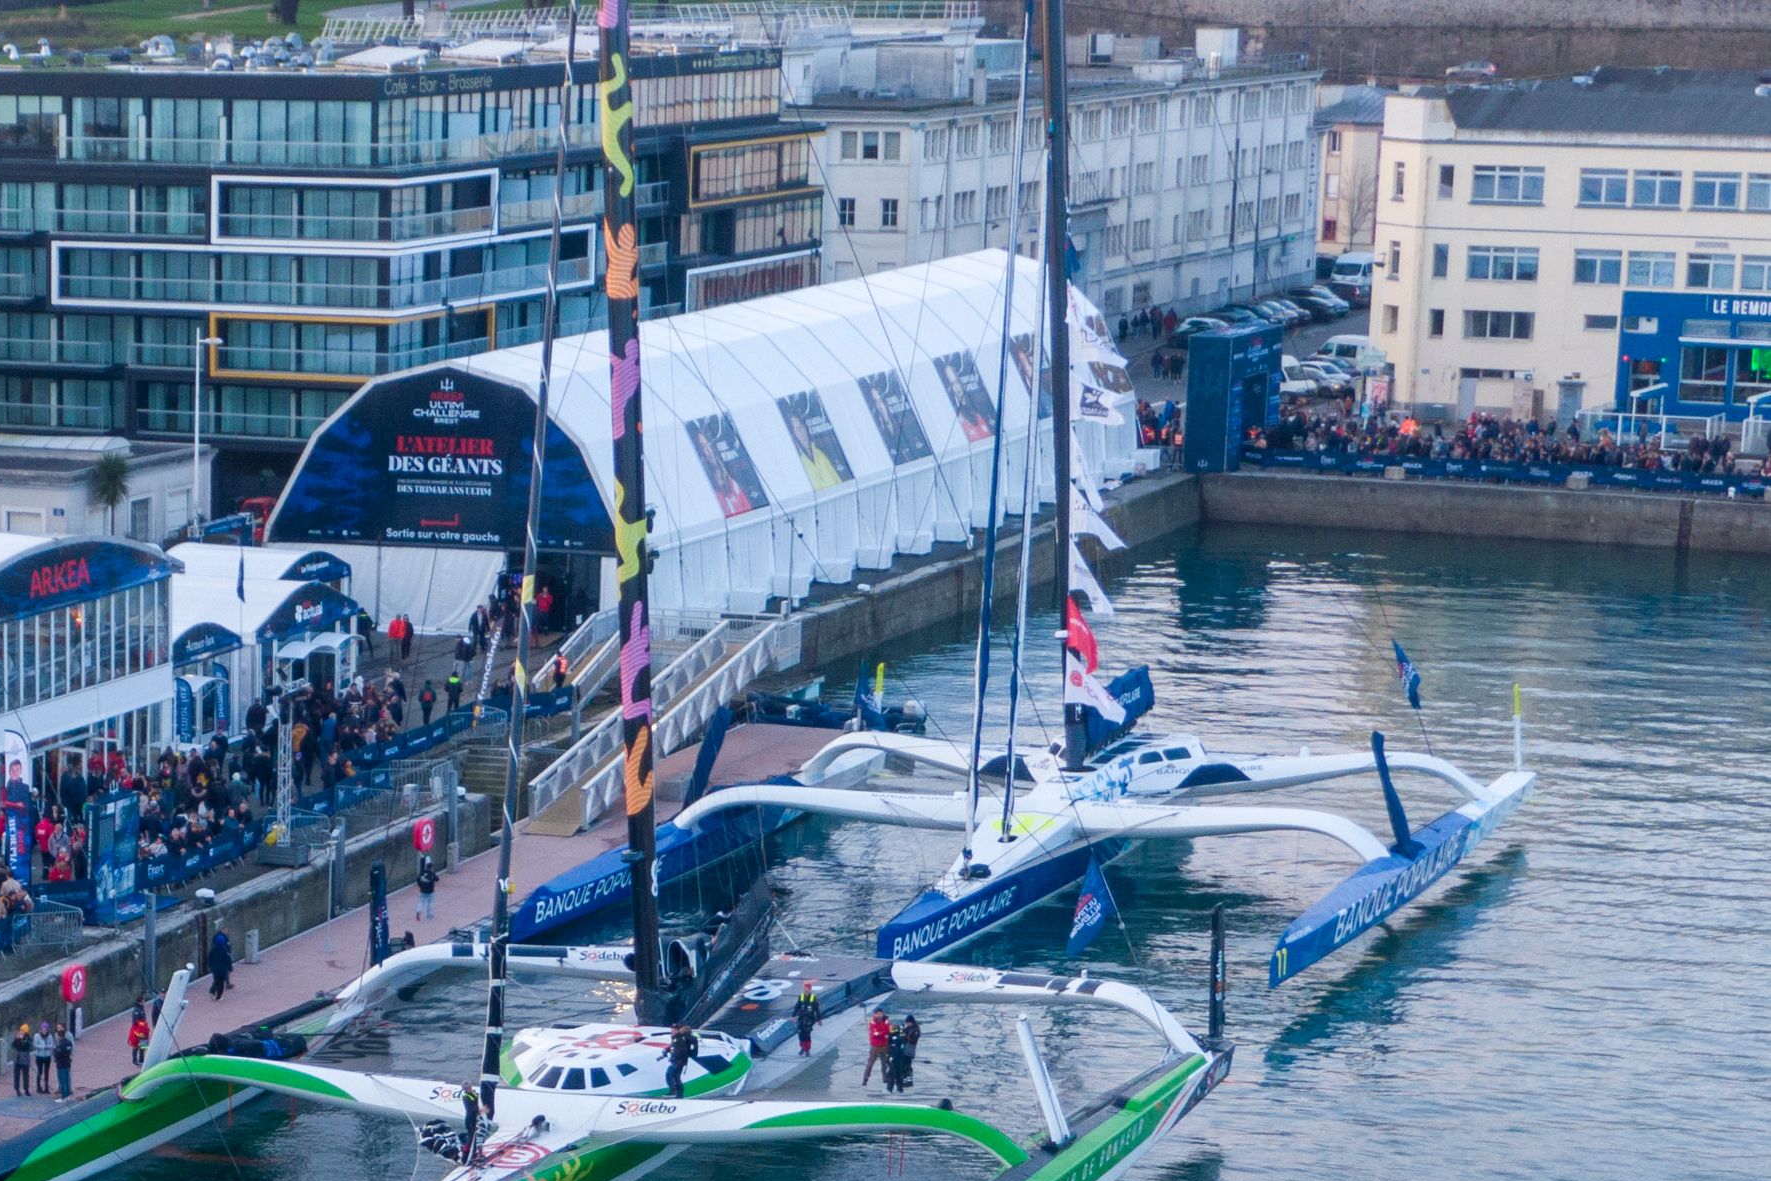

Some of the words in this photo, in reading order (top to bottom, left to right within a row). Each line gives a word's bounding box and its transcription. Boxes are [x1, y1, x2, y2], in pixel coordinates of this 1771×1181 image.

[384, 76, 408, 96] Café
[419, 74, 437, 92] Bar
[448, 72, 493, 91] Brasserie
[1713, 299, 1729, 315] LE
[412, 408, 481, 419] CHALLENGE
[429, 401, 465, 410] ULTIM
[396, 434, 495, 456] L'ATELIER
[388, 455, 425, 473] DES
[427, 453, 503, 476] GÉANTS
[397, 485, 414, 494] DES
[415, 485, 465, 496] TRIMARANS
[466, 486, 492, 497] ULTIM
[386, 528, 416, 539] Sortie
[417, 531, 433, 540] sur
[435, 531, 461, 540] votre
[463, 532, 501, 543] gauche
[30, 557, 91, 598] ARKEA
[1333, 878, 1396, 944] BANQUE
[1395, 829, 1463, 902] POPULAIRE
[534, 879, 591, 925] BANQUE
[892, 916, 946, 960] BANQUE
[948, 885, 1018, 936] POPULAIRE
[1276, 948, 1288, 978] 11
[615, 1100, 677, 1115] Sodebo
[1082, 1157, 1096, 1181] DE
[1099, 1117, 1145, 1168] BONHEUR
